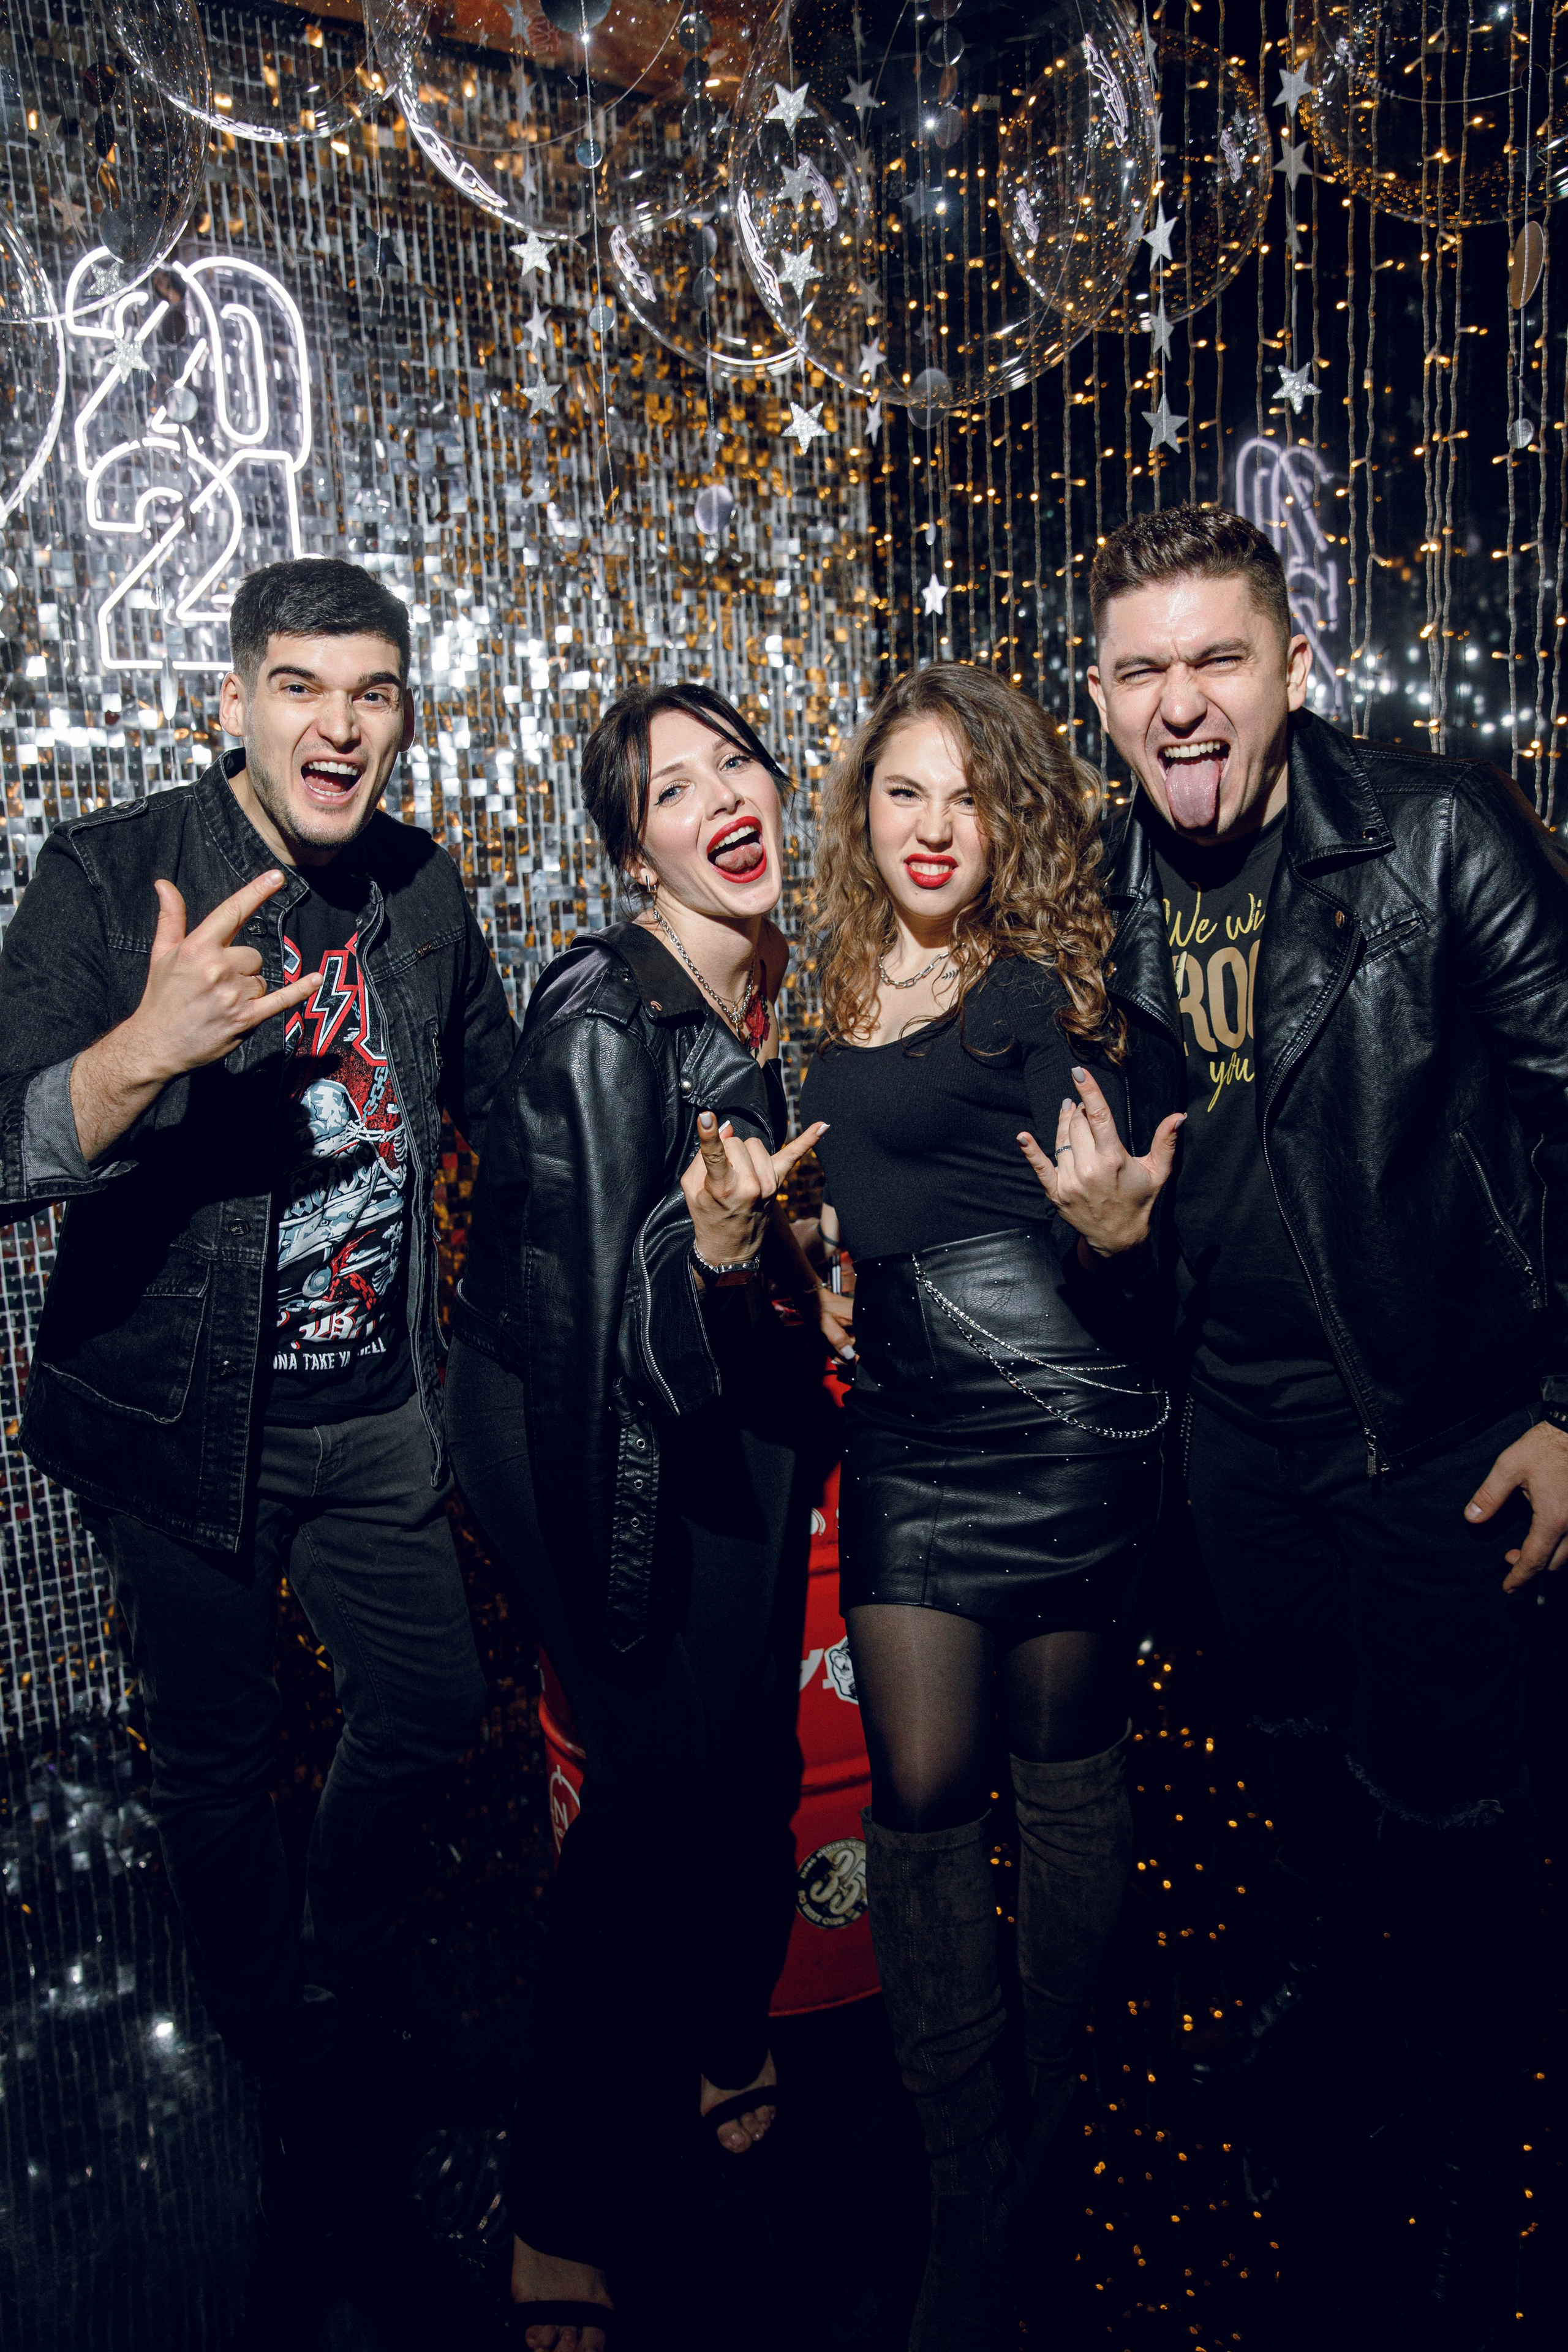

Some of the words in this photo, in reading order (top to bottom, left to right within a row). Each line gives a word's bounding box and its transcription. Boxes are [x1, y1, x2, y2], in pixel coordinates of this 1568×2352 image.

[65, 246, 312, 478] 20
[1163, 882, 1218, 948] We
[1207, 1051, 1255, 1113] you
[303, 1352, 335, 1371] TAKE
